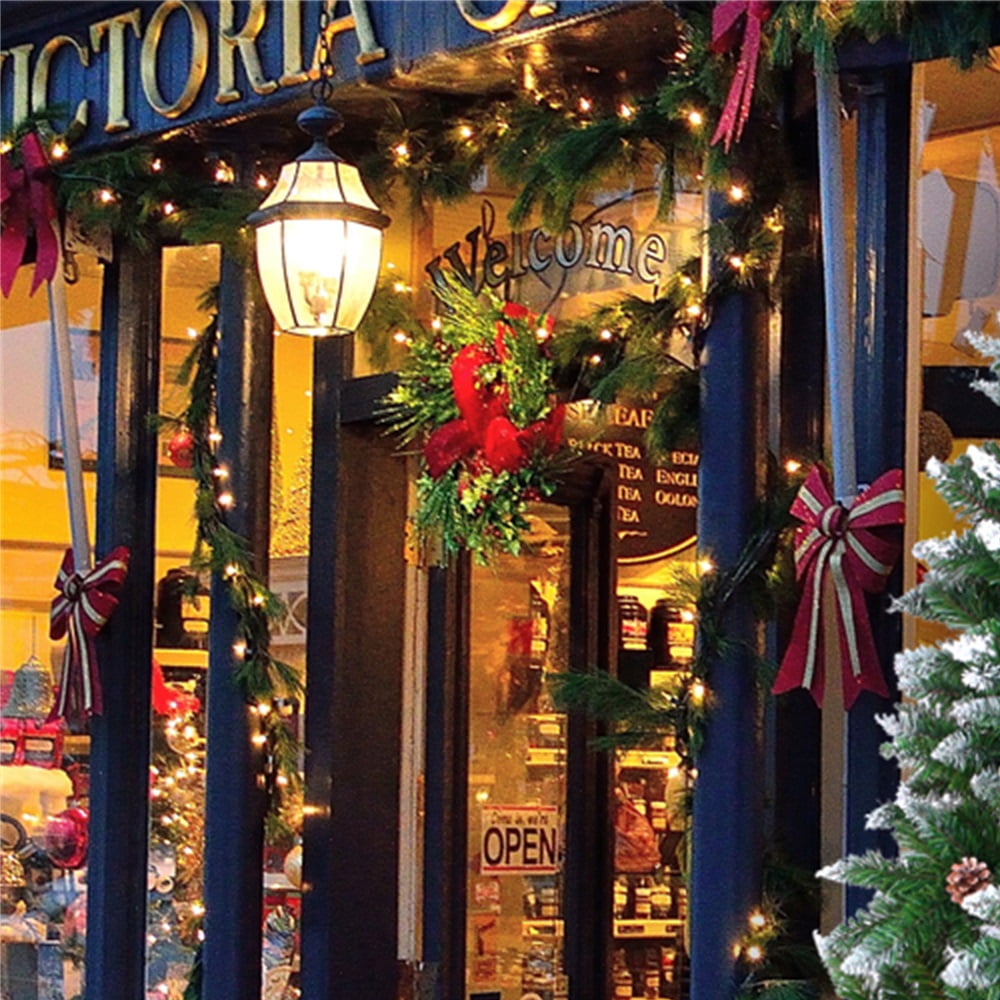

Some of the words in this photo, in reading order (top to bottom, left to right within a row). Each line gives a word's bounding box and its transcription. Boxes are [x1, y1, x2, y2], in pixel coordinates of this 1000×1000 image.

[0, 0, 386, 145] ICTORIA
[424, 214, 668, 297] Welcome
[614, 442, 641, 460] TEA
[618, 463, 643, 480] TEA
[617, 485, 642, 501] TEA
[617, 506, 640, 523] TEA
[483, 827, 557, 866] OPEN
